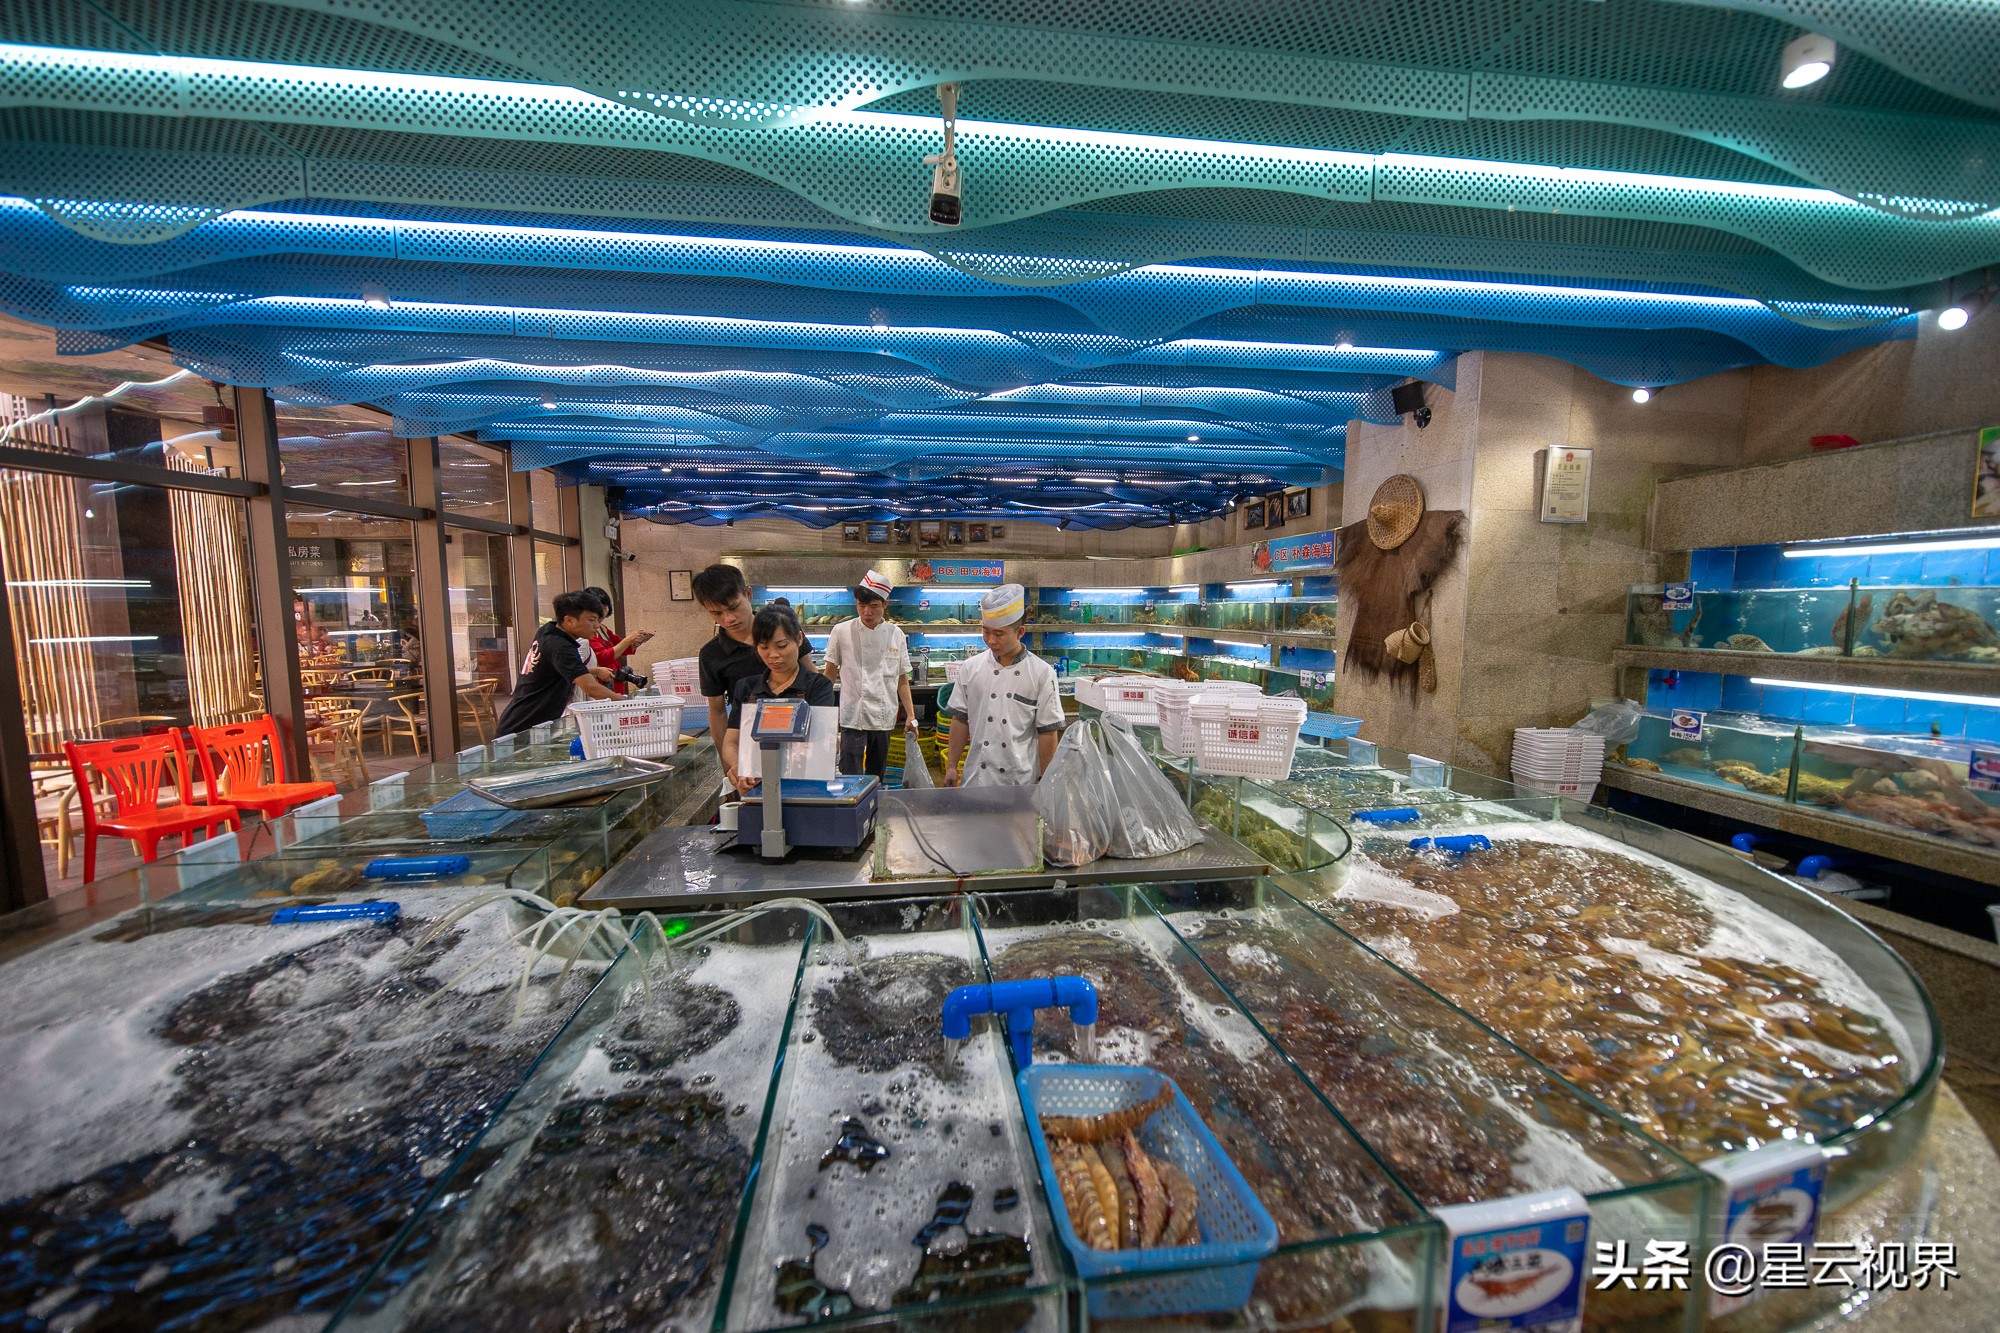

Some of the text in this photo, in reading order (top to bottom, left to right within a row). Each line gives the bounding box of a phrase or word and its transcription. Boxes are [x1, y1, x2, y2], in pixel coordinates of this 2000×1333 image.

[288, 545, 320, 558] 私房菜
[938, 566, 955, 576] B区
